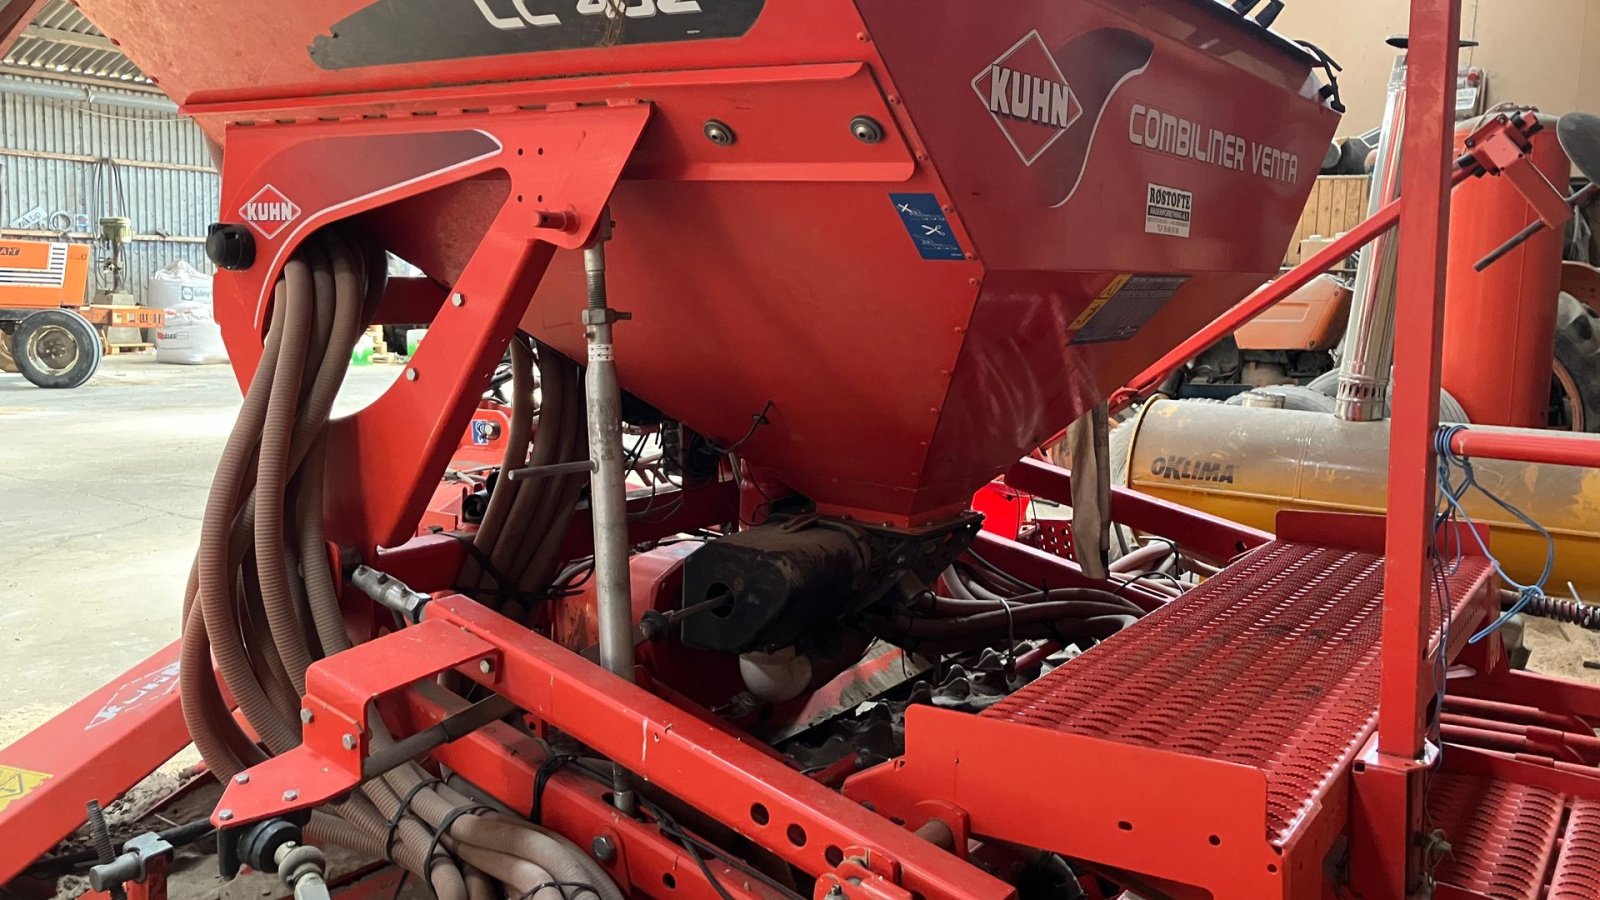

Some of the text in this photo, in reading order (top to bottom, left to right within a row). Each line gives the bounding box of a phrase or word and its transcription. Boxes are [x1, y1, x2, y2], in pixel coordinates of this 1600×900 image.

[990, 64, 1069, 128] KUHN
[1129, 103, 1298, 184] COMBILINER VENTA
[246, 202, 293, 221] KUHN
[1149, 187, 1191, 210] RØSTOFTE
